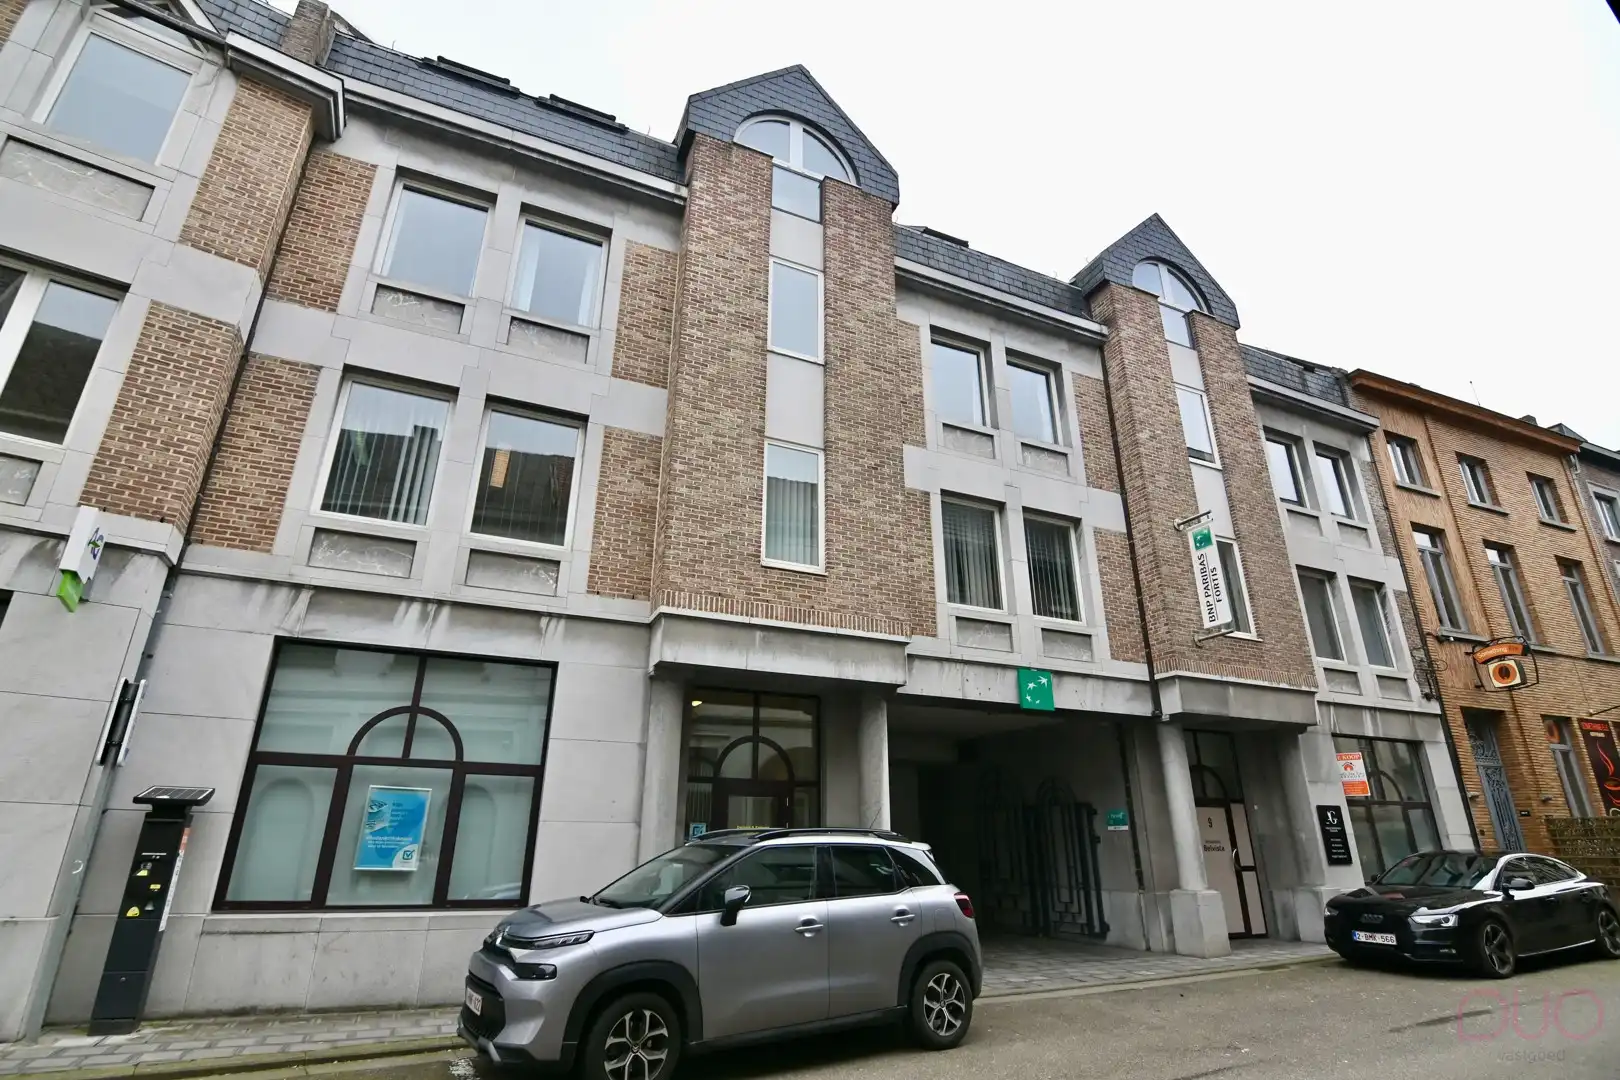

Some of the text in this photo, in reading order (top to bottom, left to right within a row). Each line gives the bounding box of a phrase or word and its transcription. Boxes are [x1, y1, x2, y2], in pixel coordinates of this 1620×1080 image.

[1198, 553, 1216, 623] BNP PARIBAS
[1211, 567, 1222, 603] FORTIS
